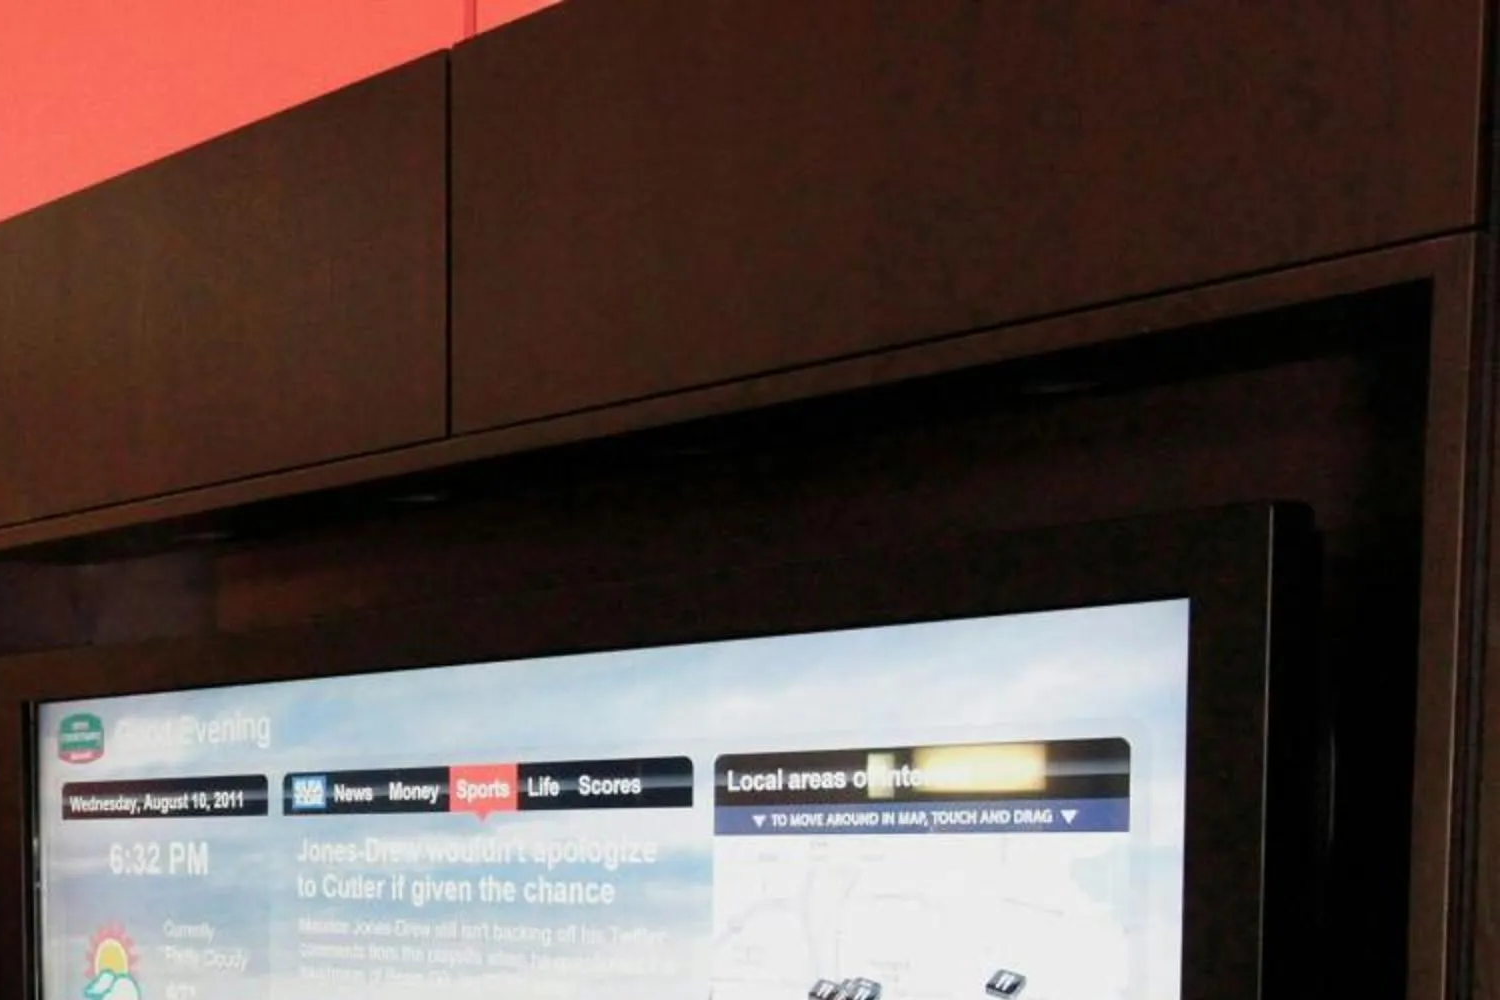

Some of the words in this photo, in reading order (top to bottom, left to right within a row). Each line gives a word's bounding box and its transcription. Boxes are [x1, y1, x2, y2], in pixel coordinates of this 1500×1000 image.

[115, 718, 172, 747] God
[178, 708, 272, 749] Evening
[455, 778, 510, 802] Sports
[527, 776, 560, 797] Life
[578, 774, 642, 796] Scores
[726, 766, 783, 793] Local
[787, 769, 846, 791] areas
[70, 794, 141, 815] Wednesday,
[143, 792, 189, 814] August
[213, 791, 244, 809] 2011
[334, 783, 373, 802] News
[388, 781, 440, 805] Money
[772, 814, 787, 828] TO
[790, 813, 824, 828] MOVE
[826, 812, 879, 828] AROUND
[881, 811, 895, 827] IN
[930, 810, 978, 827] TOUCH
[980, 809, 1011, 826] AND
[1013, 808, 1054, 825] DRAG
[108, 842, 162, 876] 6:32
[168, 841, 210, 876] PM
[297, 837, 426, 865] Jones-Drew
[427, 836, 526, 865] wouldn't
[533, 835, 658, 869] apologize
[297, 875, 317, 899] to
[322, 874, 386, 900] Cutler
[391, 874, 406, 900] if
[410, 876, 472, 906] given
[478, 875, 517, 903] the
[523, 876, 617, 905] chance
[493, 922, 553, 946] backing
